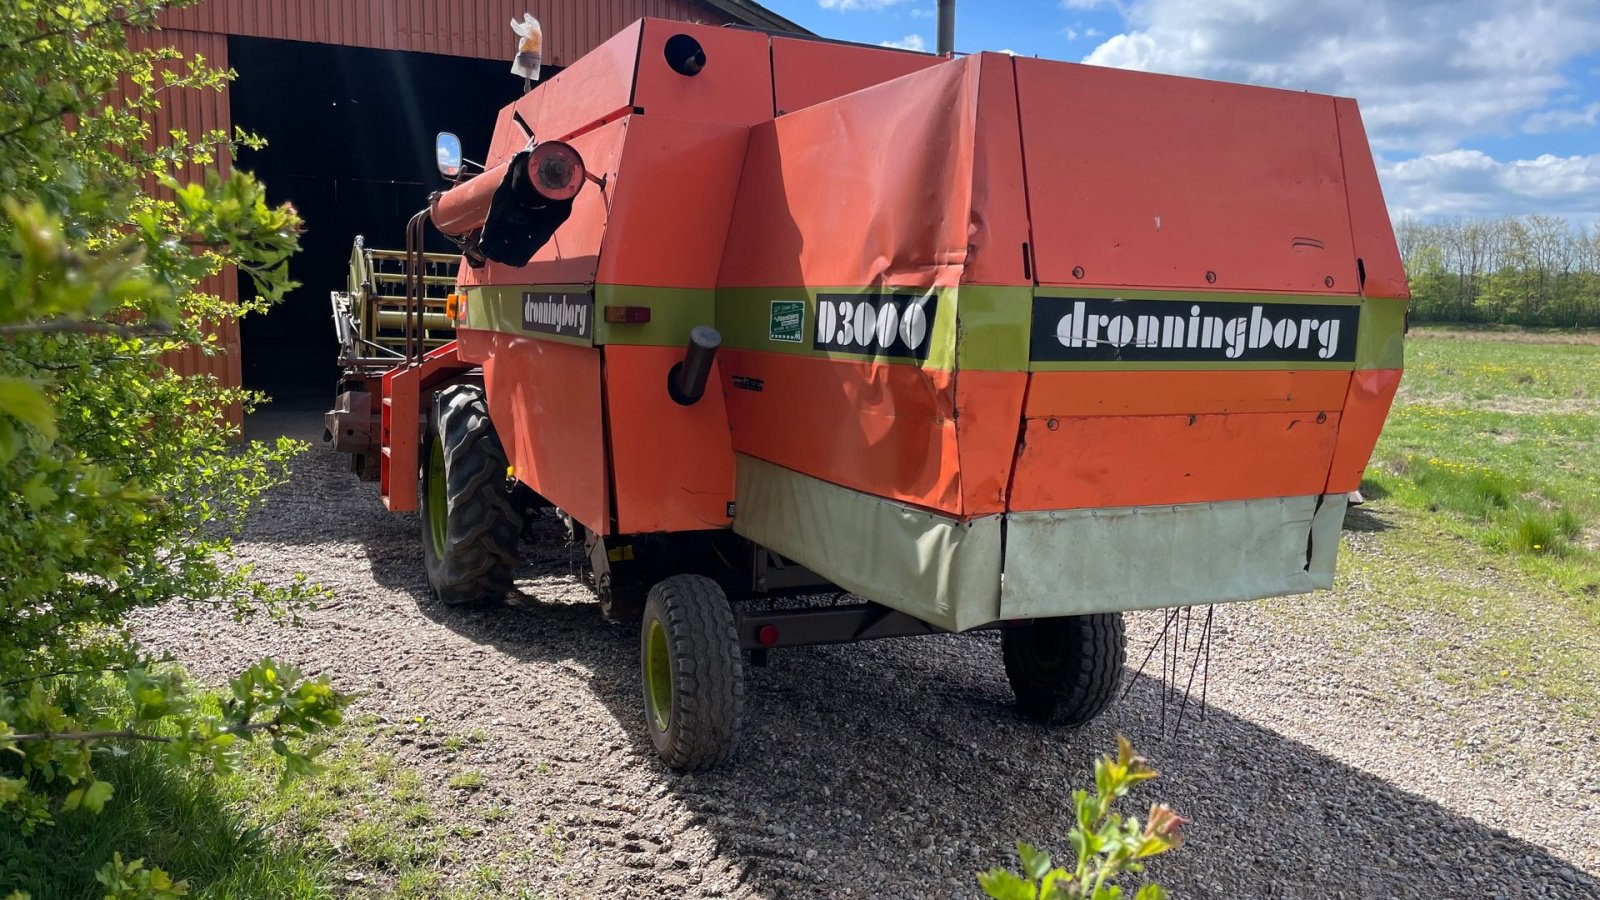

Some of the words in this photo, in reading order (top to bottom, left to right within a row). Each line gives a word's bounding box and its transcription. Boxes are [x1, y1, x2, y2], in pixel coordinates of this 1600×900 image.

[524, 294, 587, 336] dronningborg
[817, 301, 927, 351] D3000
[1056, 301, 1340, 359] dronningborg
